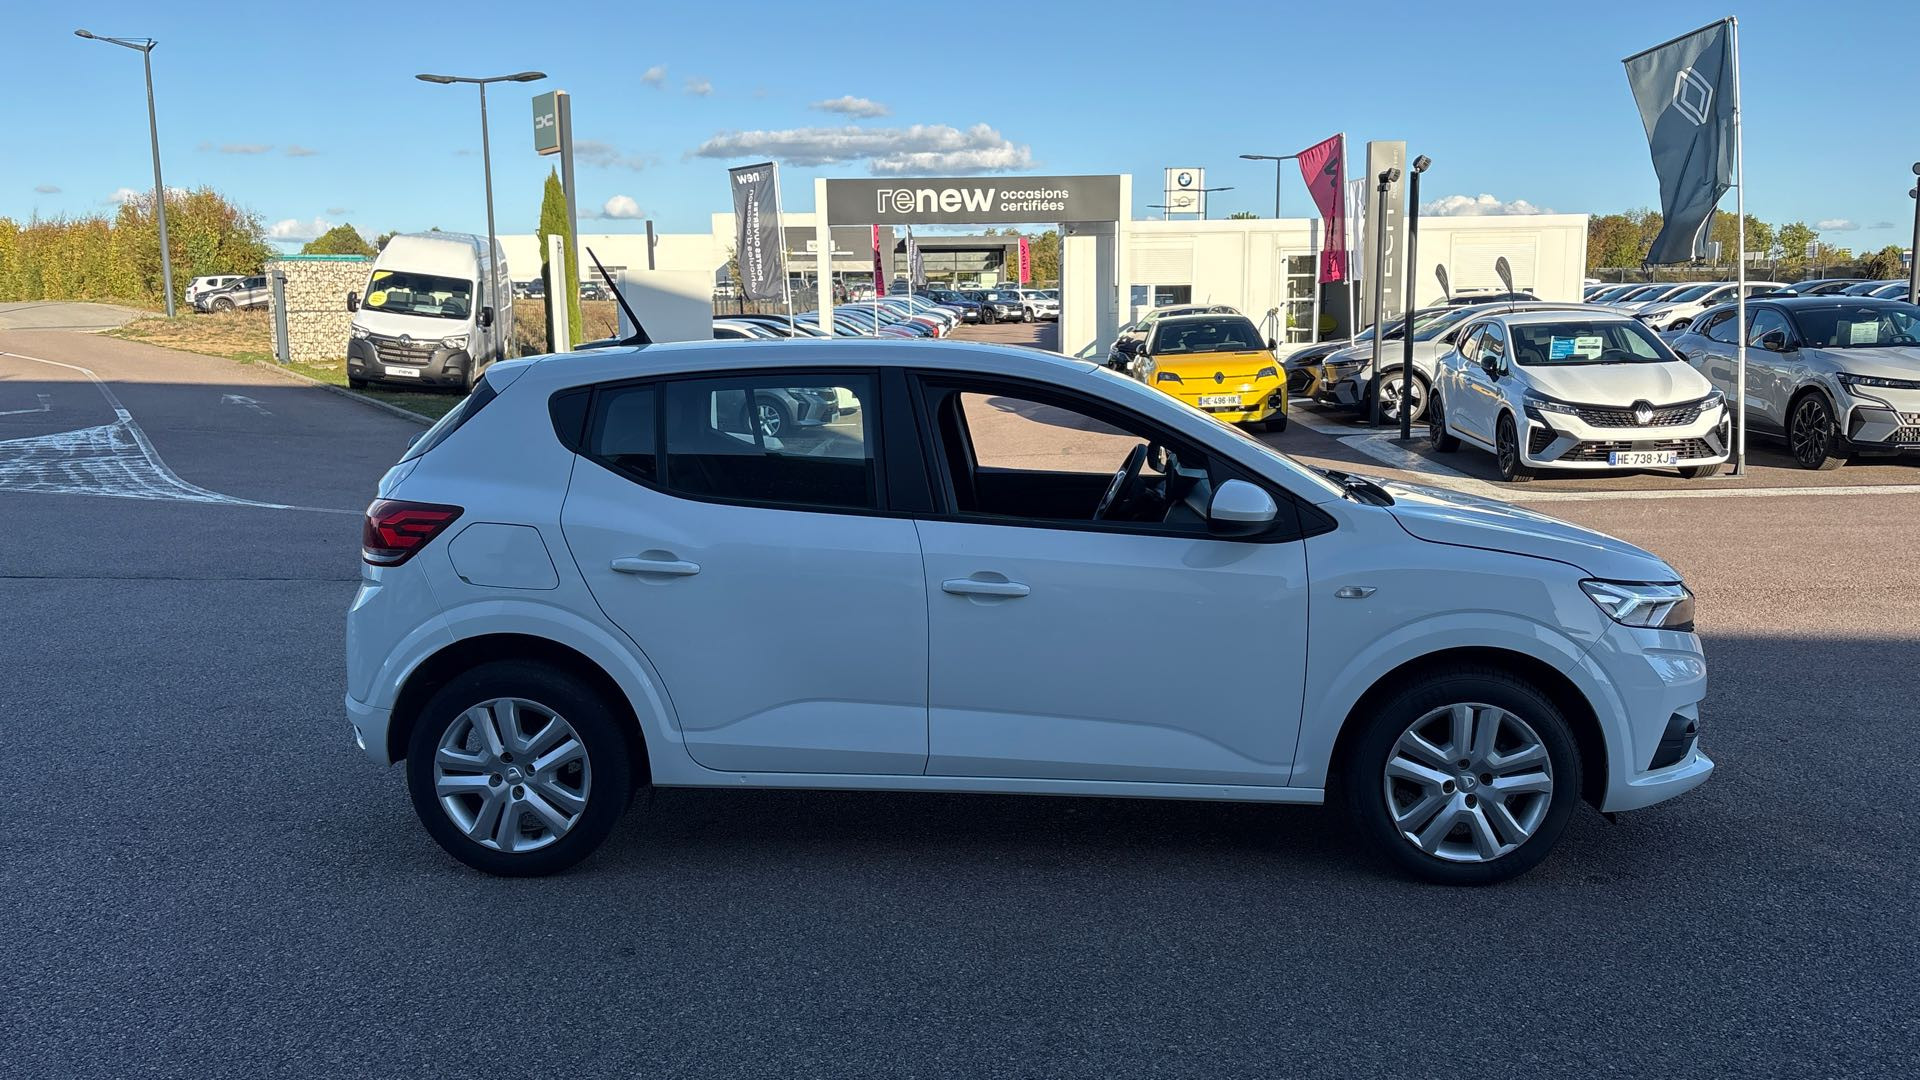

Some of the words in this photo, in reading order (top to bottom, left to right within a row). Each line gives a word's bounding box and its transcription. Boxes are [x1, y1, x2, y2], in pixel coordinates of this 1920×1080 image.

[1000, 187, 1069, 200] occasions
[877, 188, 996, 214] renew
[1000, 199, 1065, 212] certifiées
[1617, 453, 1669, 465] HE-738-XJ
